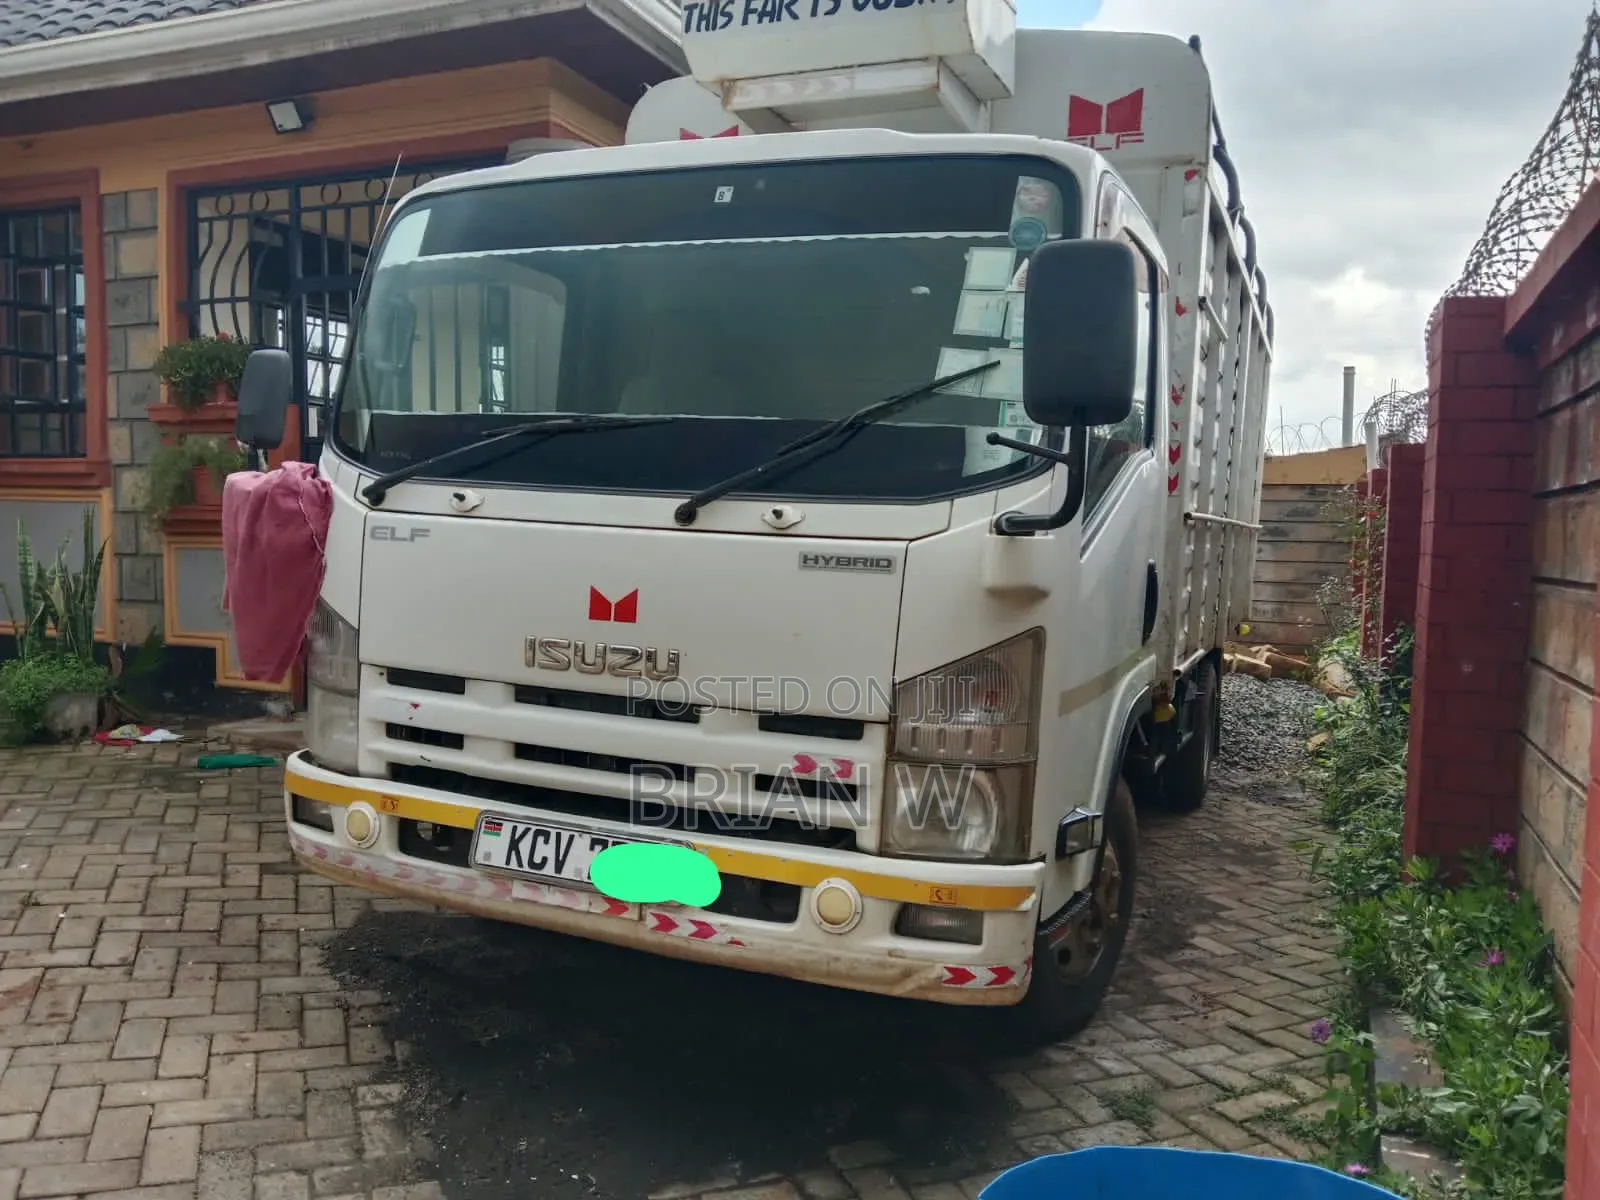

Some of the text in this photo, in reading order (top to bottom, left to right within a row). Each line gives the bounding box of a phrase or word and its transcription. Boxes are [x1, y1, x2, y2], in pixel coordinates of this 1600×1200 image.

[683, 0, 735, 34] THIS
[740, 0, 800, 26] FAR
[370, 525, 431, 543] ELF
[802, 554, 893, 569] HYBRID
[525, 635, 680, 682] ISUZU
[504, 824, 576, 875] KCV
